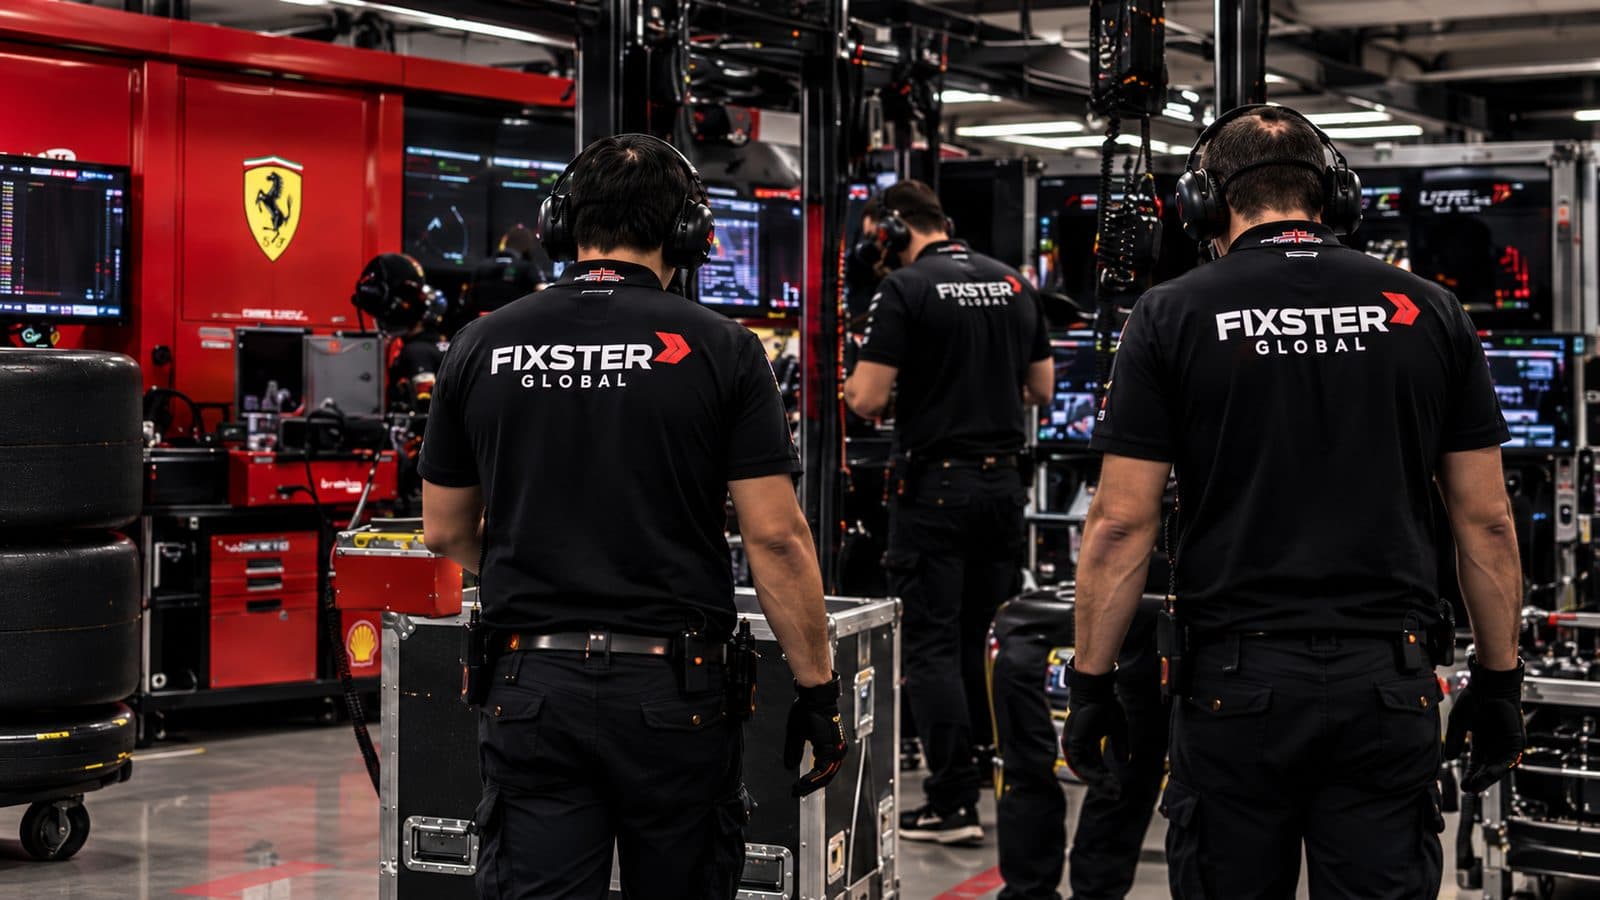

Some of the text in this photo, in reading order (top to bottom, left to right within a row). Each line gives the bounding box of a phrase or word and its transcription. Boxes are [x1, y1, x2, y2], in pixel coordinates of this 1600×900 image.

[936, 280, 1014, 300] FIXSTER
[957, 296, 1008, 307] GLOBAL
[1215, 304, 1389, 341] FIXSTER
[1255, 338, 1366, 355] GLOBAL
[490, 343, 653, 375] FIXSTER
[521, 372, 627, 389] GLOBAL
